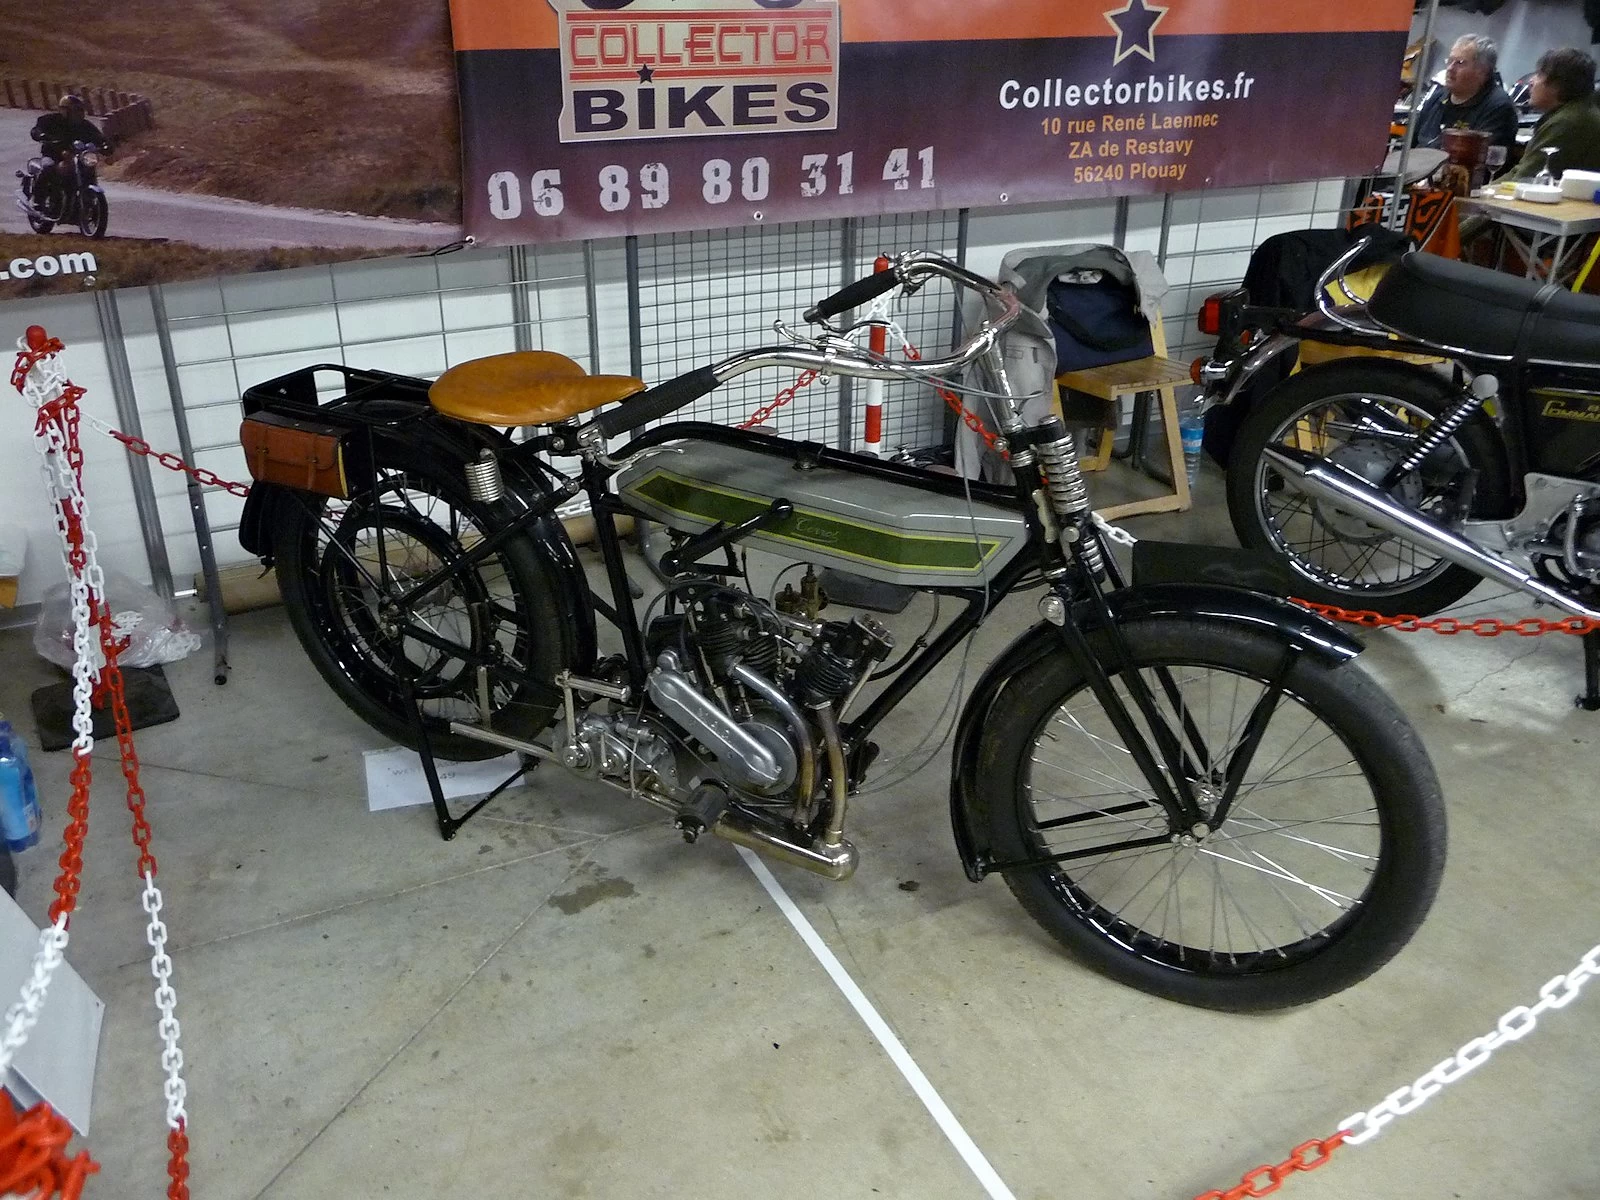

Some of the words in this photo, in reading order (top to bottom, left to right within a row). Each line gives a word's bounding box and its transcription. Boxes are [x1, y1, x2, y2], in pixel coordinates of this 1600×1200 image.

[569, 23, 831, 67] COLLECTOR
[573, 81, 831, 134] BIKES
[999, 71, 1254, 109] Collectorbikes.fr
[1041, 118, 1062, 135] 10
[1068, 119, 1096, 134] rue
[1102, 112, 1146, 132] René
[1151, 113, 1219, 130] Laennec
[1068, 141, 1093, 160] ZA
[1099, 140, 1119, 156] de
[1125, 139, 1194, 157] Restavy
[488, 169, 564, 219] 06
[599, 162, 670, 211] 89
[702, 157, 769, 203] 80
[801, 151, 854, 197] 31
[882, 146, 935, 191] 41
[1073, 165, 1124, 183] 56240
[1130, 161, 1187, 182] Plouay
